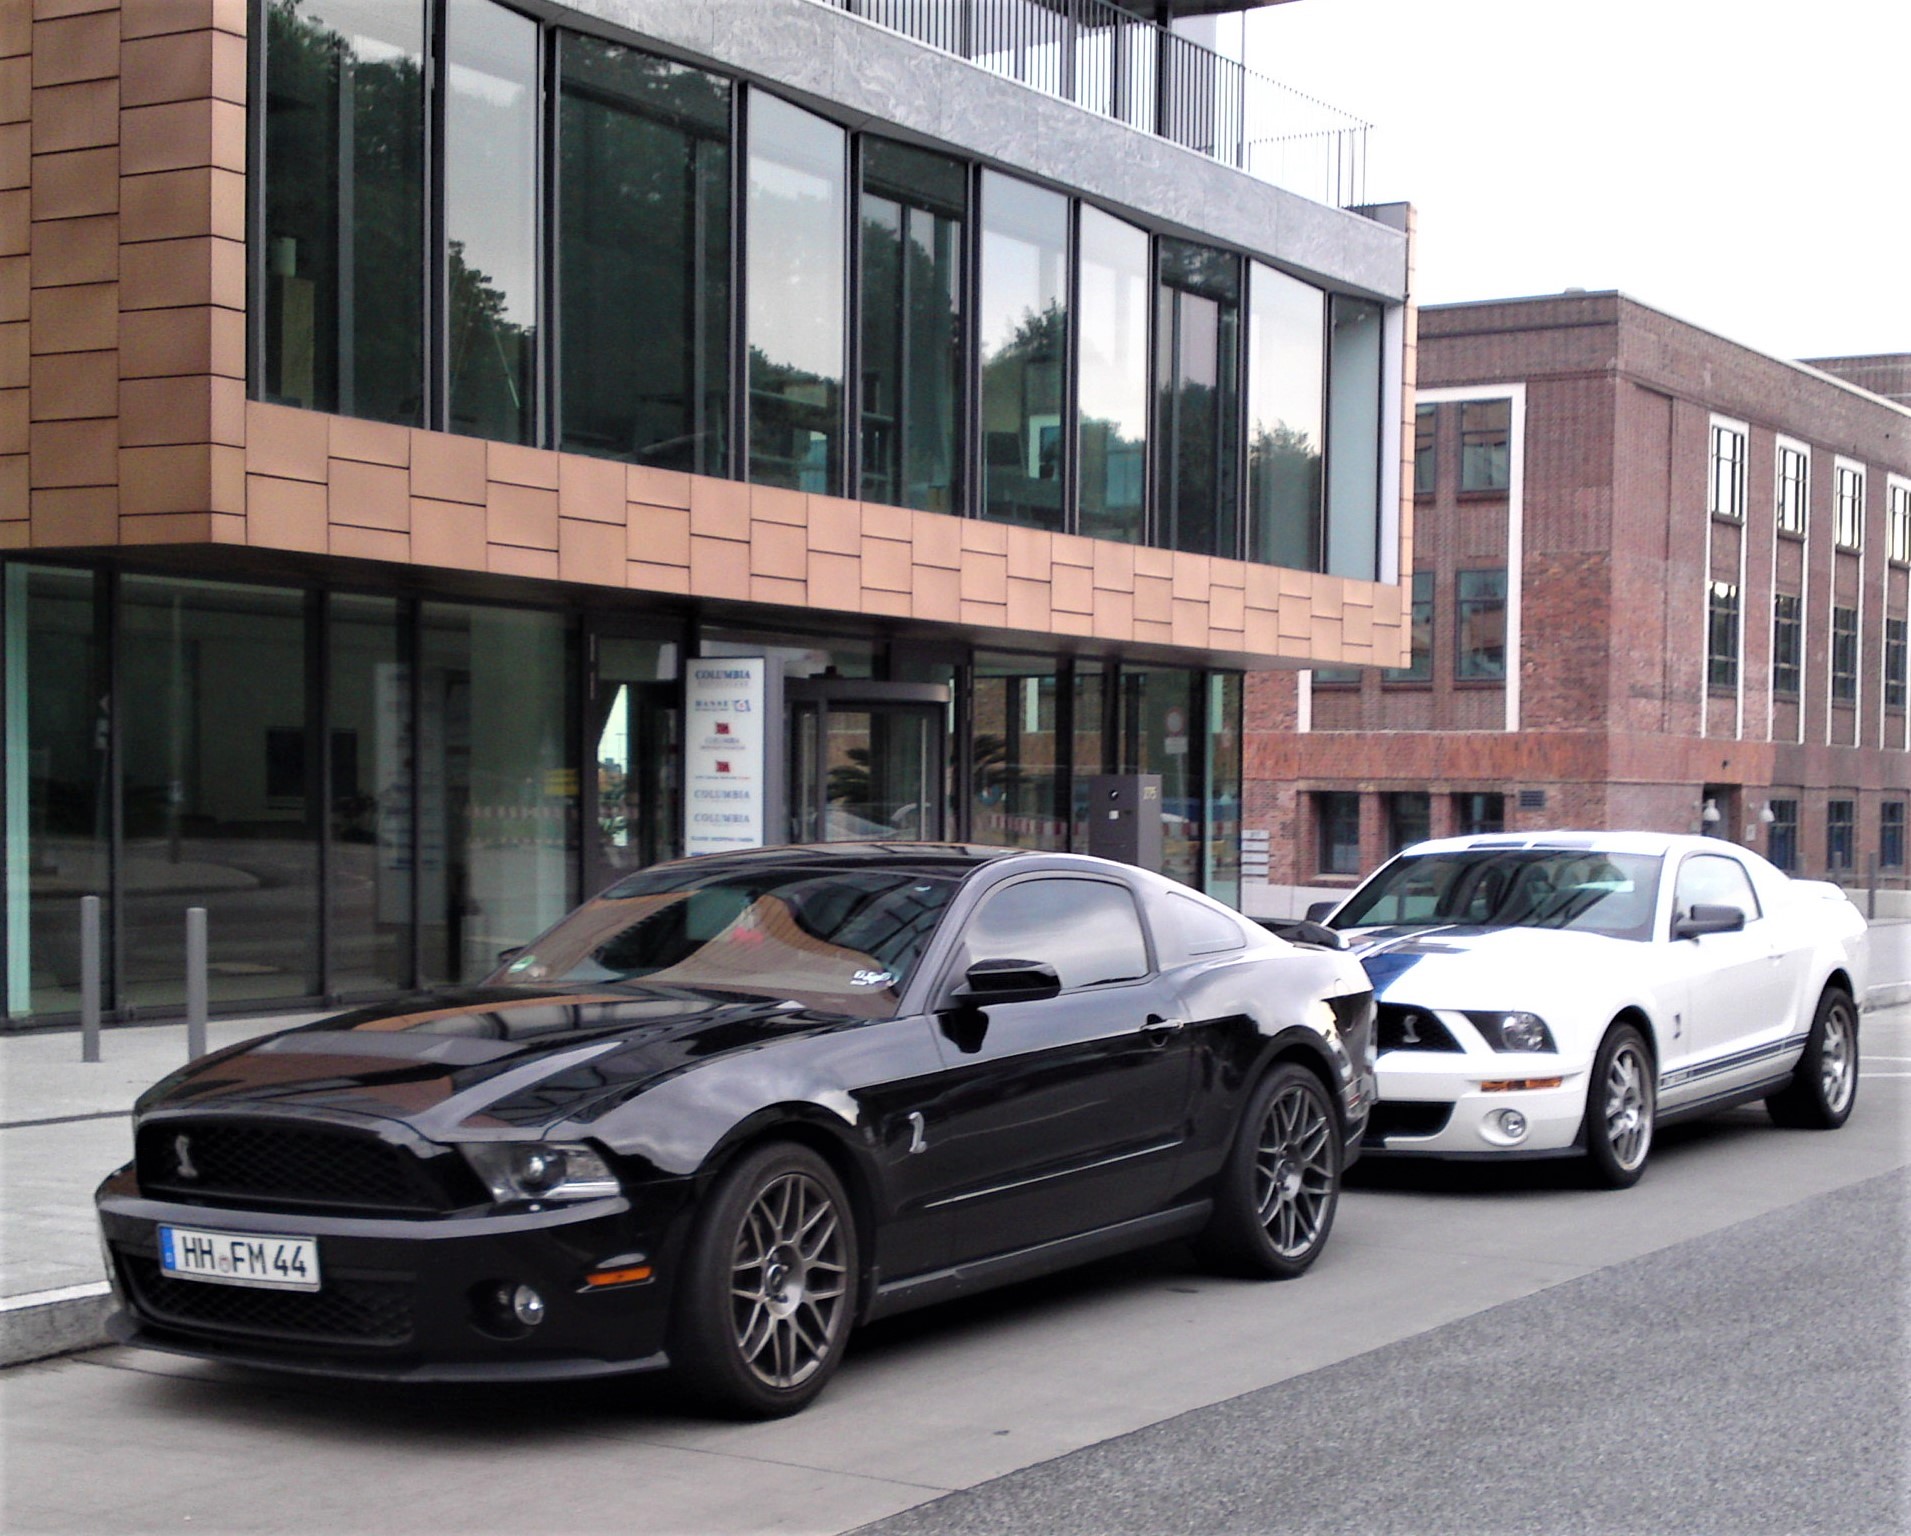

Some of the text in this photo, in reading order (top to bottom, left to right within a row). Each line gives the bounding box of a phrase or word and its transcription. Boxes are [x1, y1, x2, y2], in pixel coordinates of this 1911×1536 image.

[695, 670, 751, 679] COLUMBIA
[693, 789, 750, 799] COLUMBIA
[693, 813, 750, 823] COLUMBIA
[181, 1236, 307, 1278] HH FM 44
